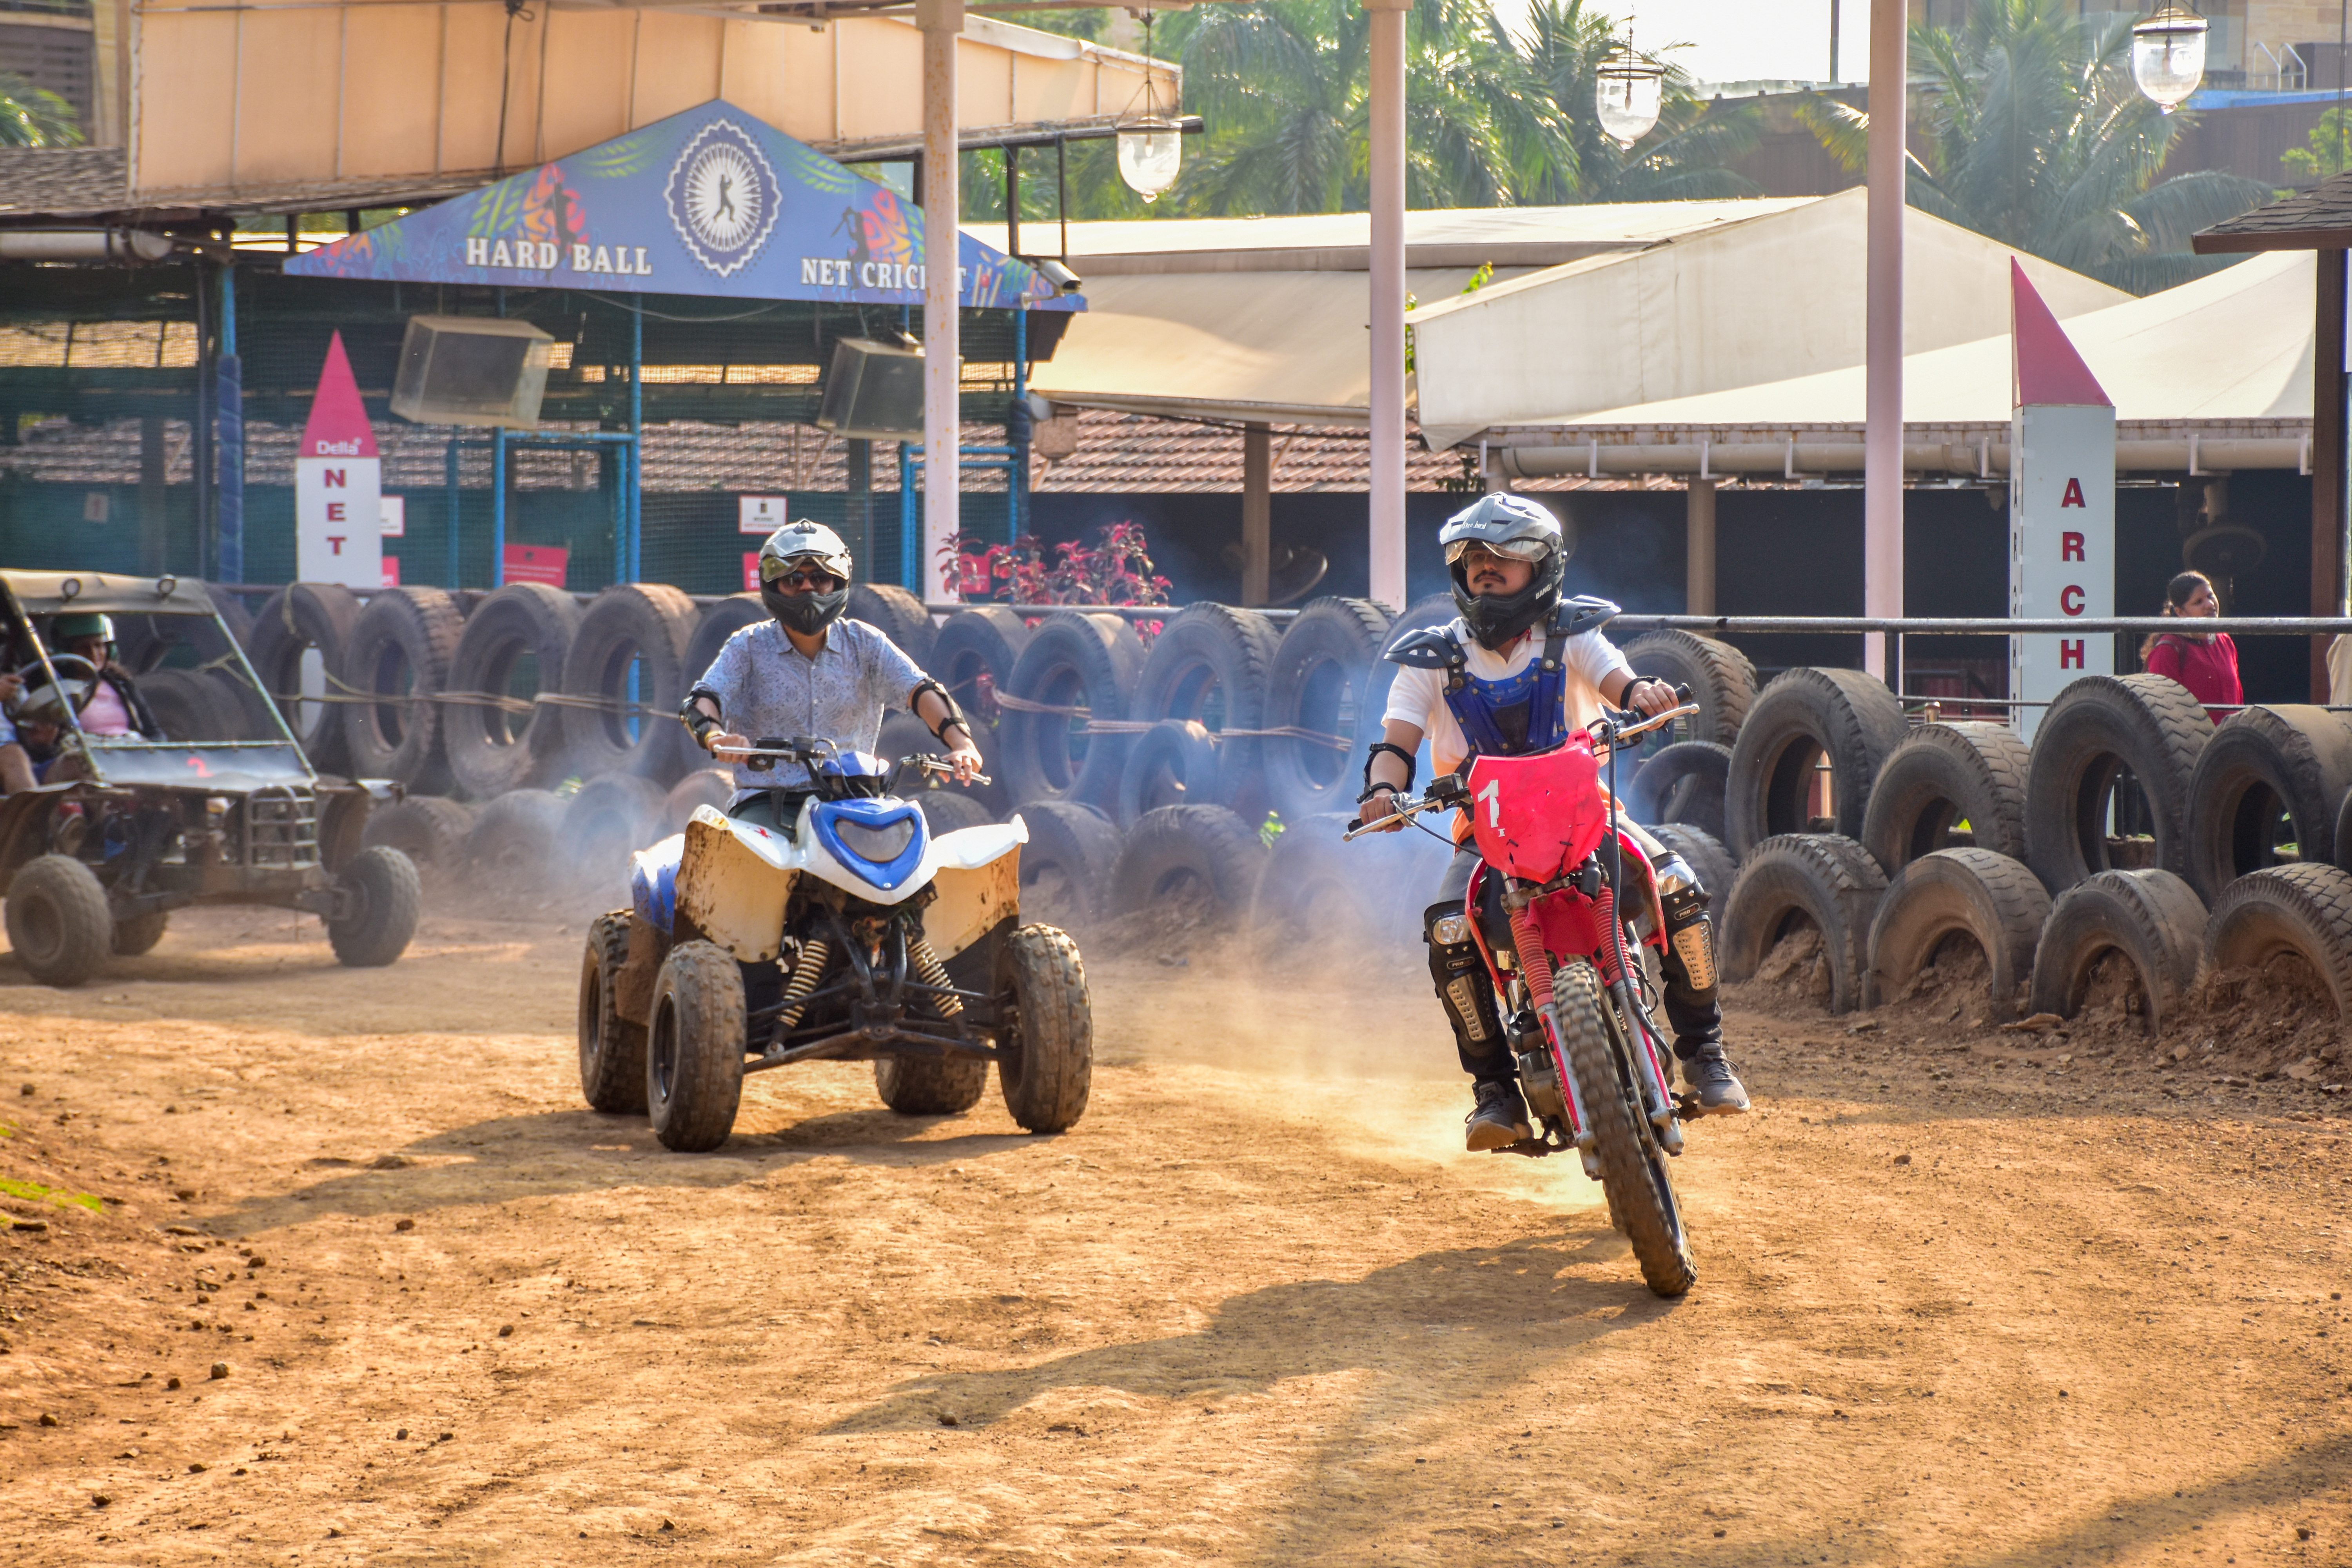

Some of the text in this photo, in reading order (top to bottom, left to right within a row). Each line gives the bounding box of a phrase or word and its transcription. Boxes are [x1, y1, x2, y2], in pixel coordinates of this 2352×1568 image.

[466, 236, 652, 275] HARD BALL
[801, 258, 967, 292] NET CRICT
[325, 469, 347, 555] NET
[1535, 583, 1552, 600] BANG!
[2061, 478, 2086, 670] ARCH
[187, 757, 214, 778] 2
[1477, 779, 1500, 828] 1
